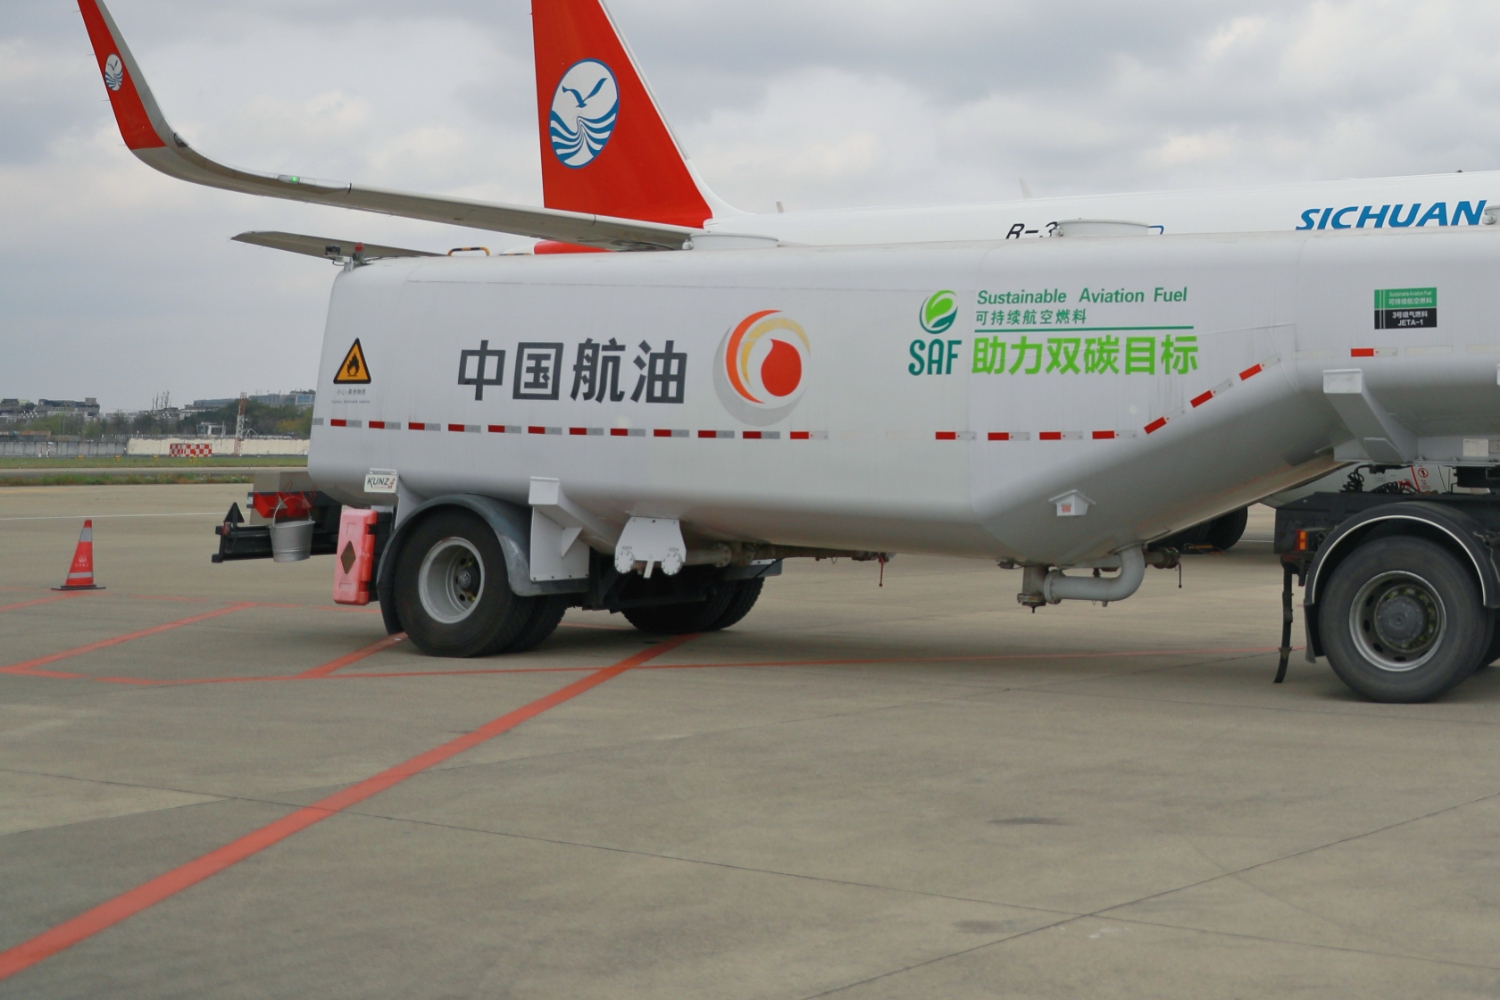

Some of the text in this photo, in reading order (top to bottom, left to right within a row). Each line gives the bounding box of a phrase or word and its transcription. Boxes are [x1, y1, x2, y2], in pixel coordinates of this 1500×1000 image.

[1295, 199, 1488, 230] SICHUAN
[977, 287, 1188, 305] Sustainable Aviation Fuel
[975, 308, 1087, 326] 可持续航空燃料
[908, 338, 962, 376] SAF
[971, 333, 1199, 376] 助力双碳目标
[457, 338, 688, 404] 中国航油
[367, 477, 390, 489] KUNZ
